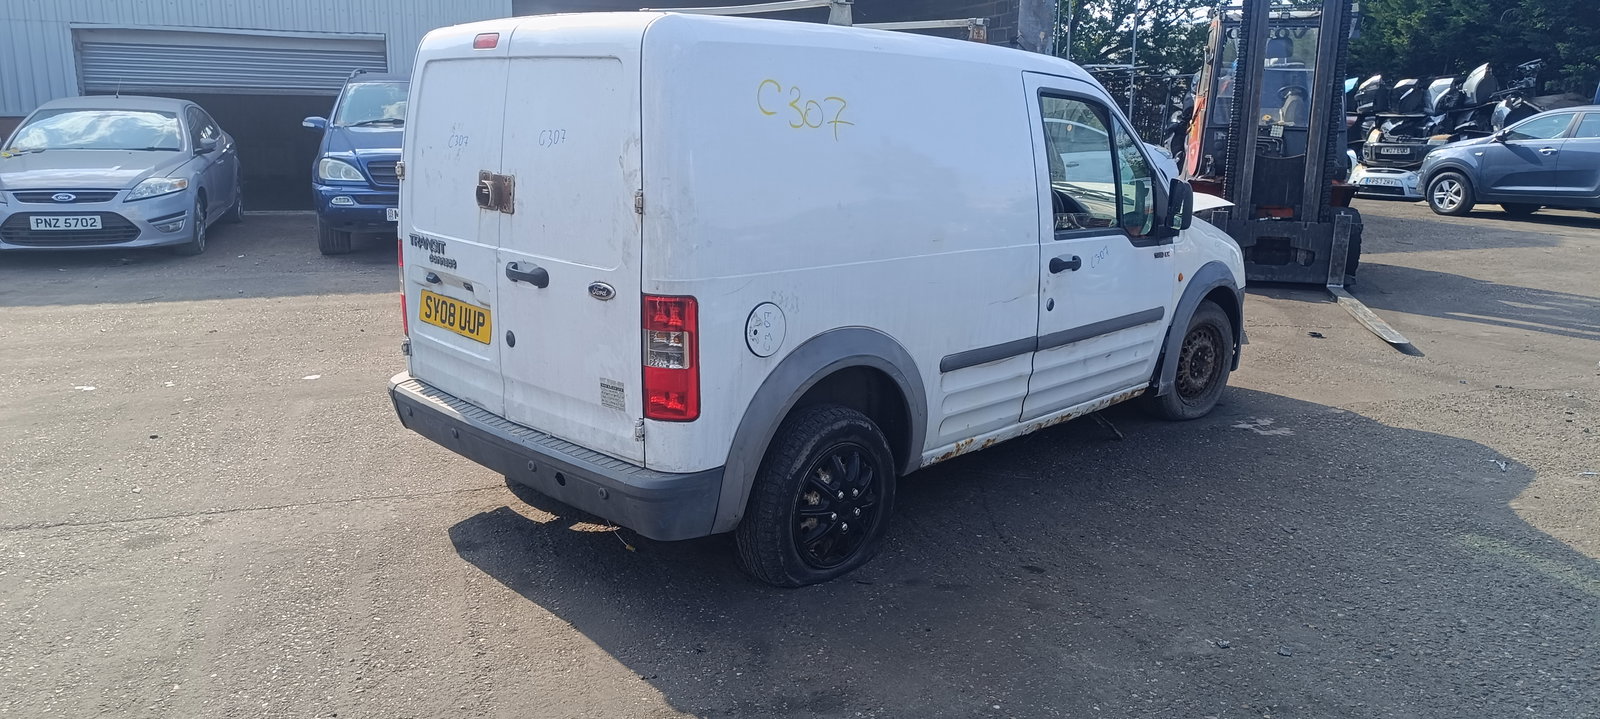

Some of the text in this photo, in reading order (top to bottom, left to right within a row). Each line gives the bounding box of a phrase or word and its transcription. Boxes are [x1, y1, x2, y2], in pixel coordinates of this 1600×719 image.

[757, 79, 855, 141] C307
[448, 134, 469, 149] C307
[35, 217, 97, 228] PNZ 5702
[409, 232, 446, 255] TRANSIT
[591, 285, 608, 296] Ford
[424, 295, 486, 336] SY08 UUP
